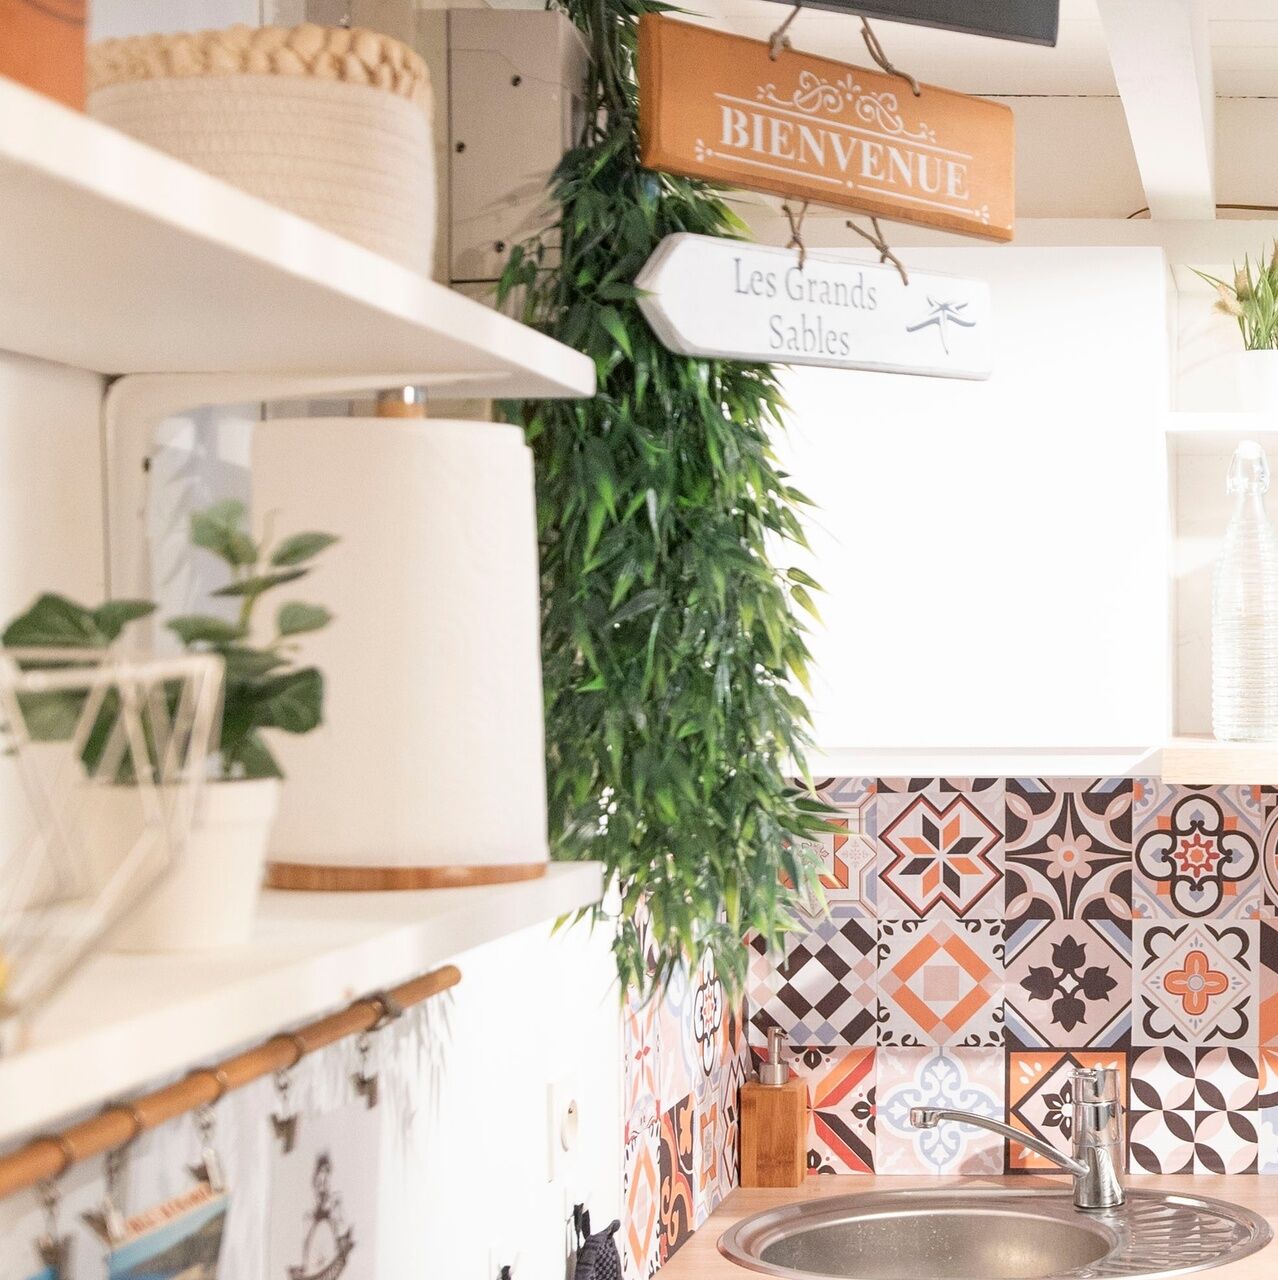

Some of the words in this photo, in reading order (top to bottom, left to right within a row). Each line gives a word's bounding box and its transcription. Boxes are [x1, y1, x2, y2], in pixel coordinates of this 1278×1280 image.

[720, 105, 970, 201] BIENVENUE
[733, 257, 777, 298] Les
[784, 266, 877, 311] Grands
[768, 313, 850, 356] Sables
